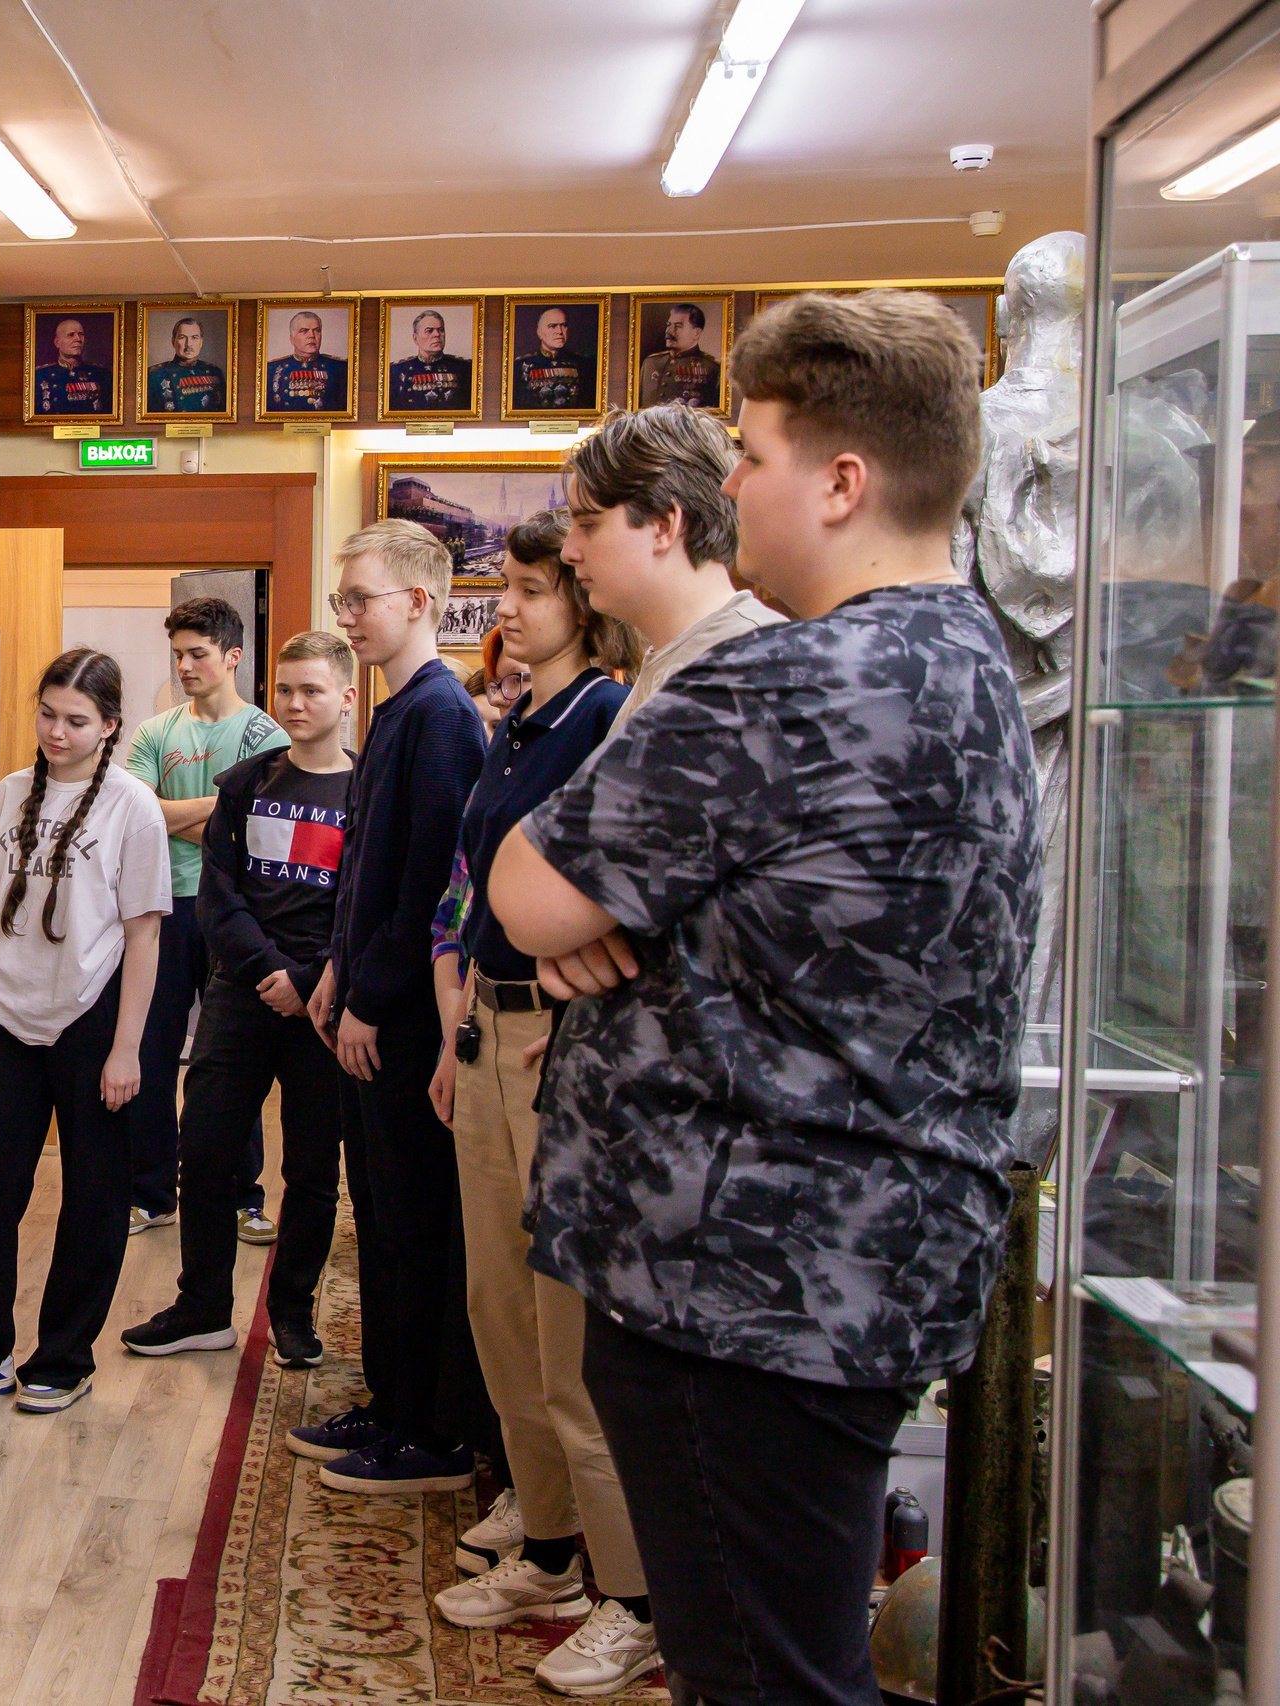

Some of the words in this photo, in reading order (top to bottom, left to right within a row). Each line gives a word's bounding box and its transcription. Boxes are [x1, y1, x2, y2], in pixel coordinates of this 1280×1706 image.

[87, 445, 148, 463] ВЫХОД
[252, 799, 347, 827] TOMMY
[246, 857, 331, 885] JEANS
